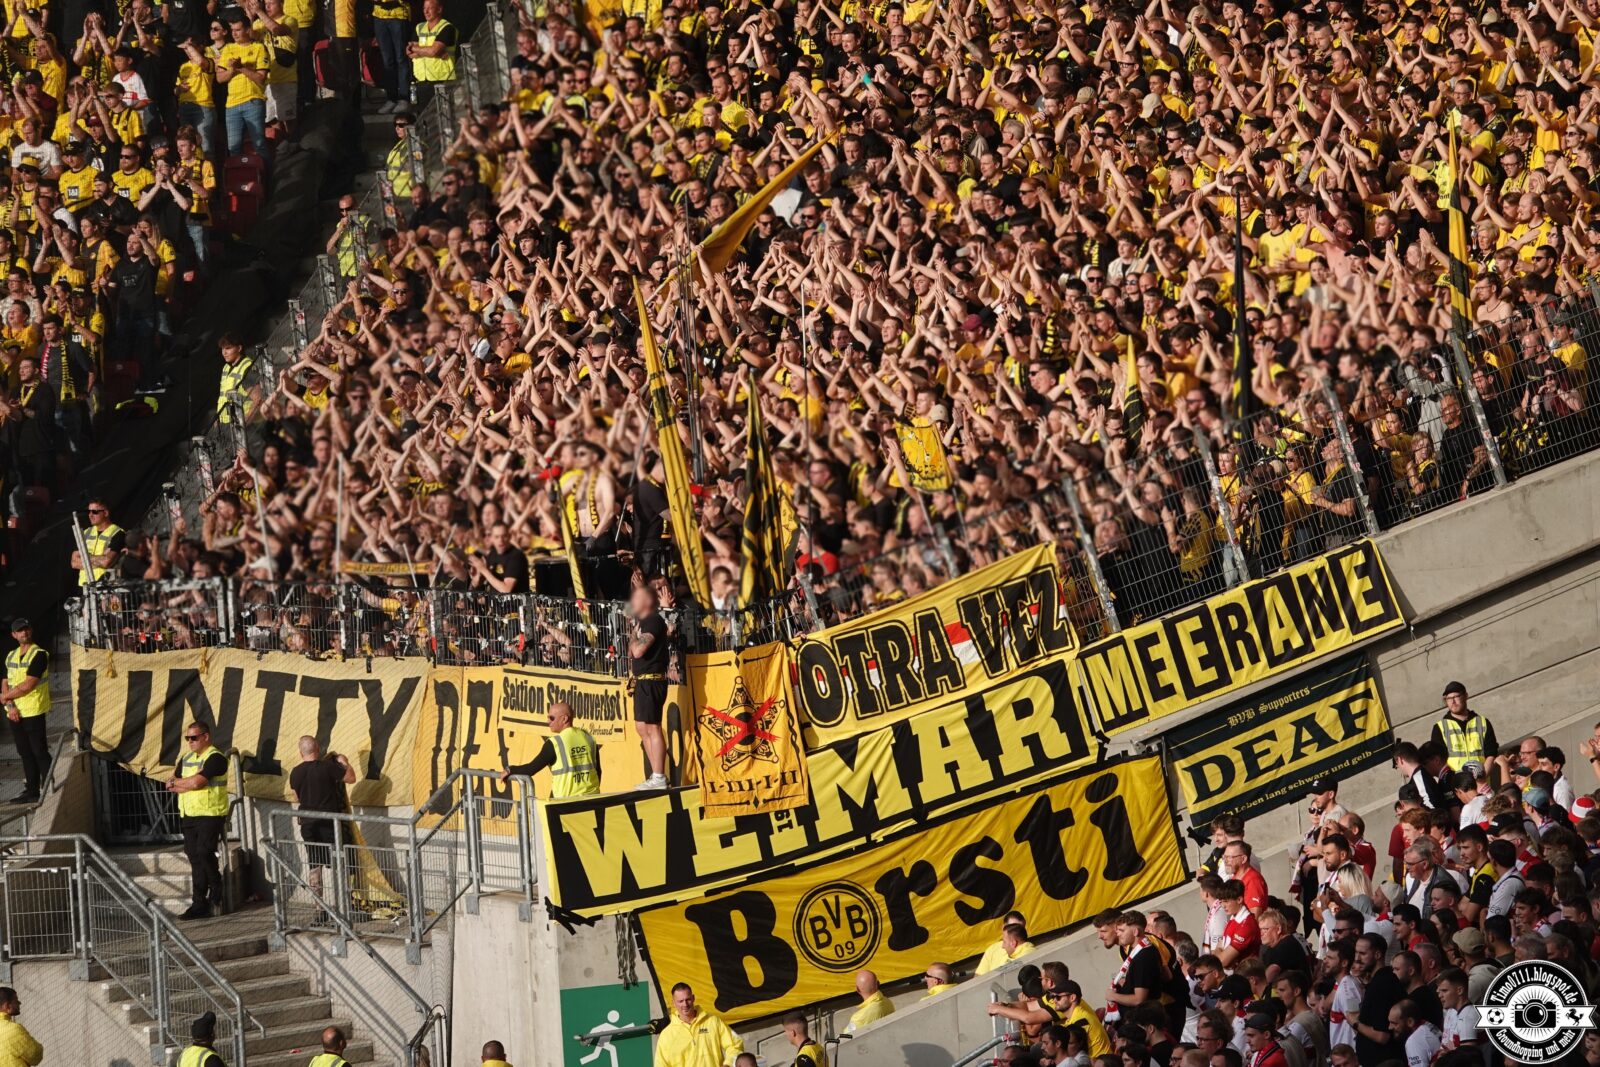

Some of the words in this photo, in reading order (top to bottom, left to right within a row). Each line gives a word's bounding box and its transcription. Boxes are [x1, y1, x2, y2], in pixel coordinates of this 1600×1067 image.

[796, 608, 966, 728] OTRA
[958, 563, 1073, 679] VEZ
[1085, 552, 1388, 728] MEERANE
[77, 667, 421, 780] UNITY
[1182, 688, 1374, 805] DEAF
[1226, 709, 1256, 729] BVB
[1258, 686, 1311, 714] Supporters
[1265, 787, 1287, 801] lang
[1288, 769, 1330, 790] schwarz
[1331, 759, 1350, 773] und
[1351, 750, 1372, 766] gelb
[808, 894, 869, 950] BVB
[834, 940, 856, 959] 09
